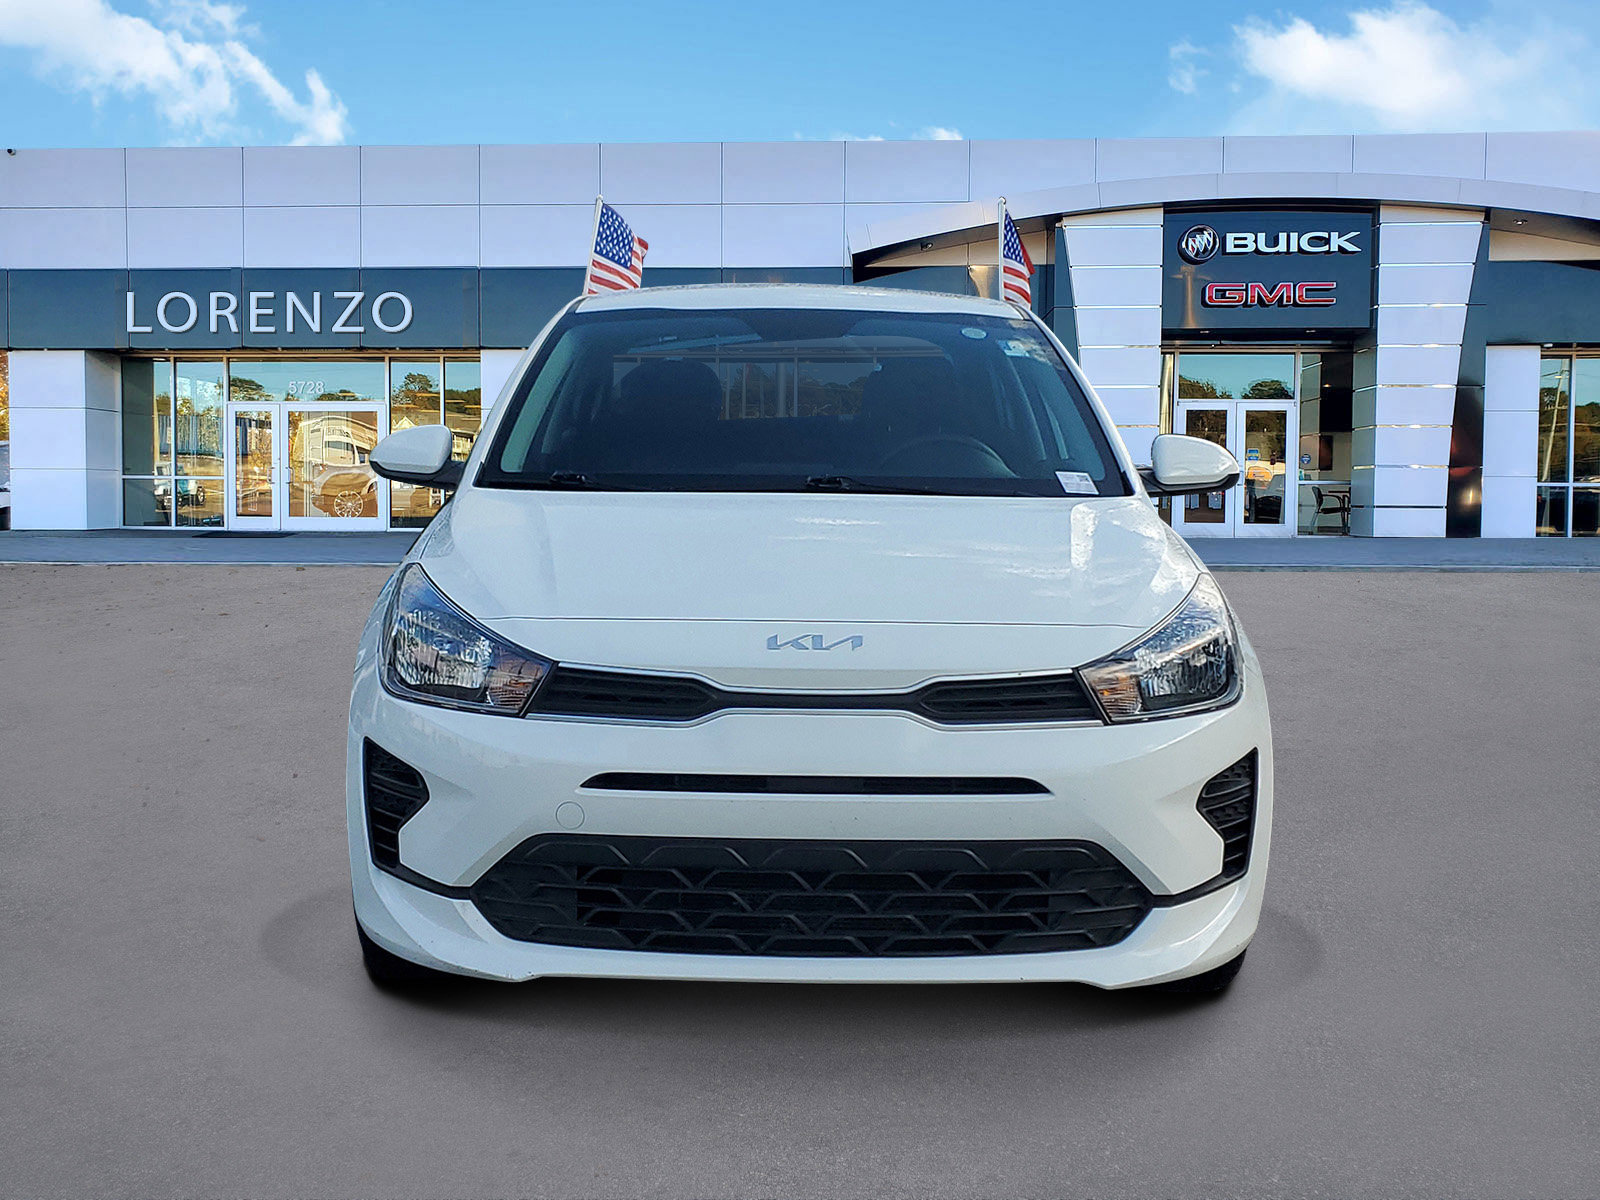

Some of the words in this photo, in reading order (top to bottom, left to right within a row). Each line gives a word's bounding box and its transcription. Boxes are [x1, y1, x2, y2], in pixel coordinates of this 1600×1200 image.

[1225, 231, 1362, 253] BUICK
[1204, 281, 1337, 305] GMC
[126, 291, 413, 333] LORENZO
[288, 381, 325, 394] 5728
[766, 633, 863, 651] KIA
